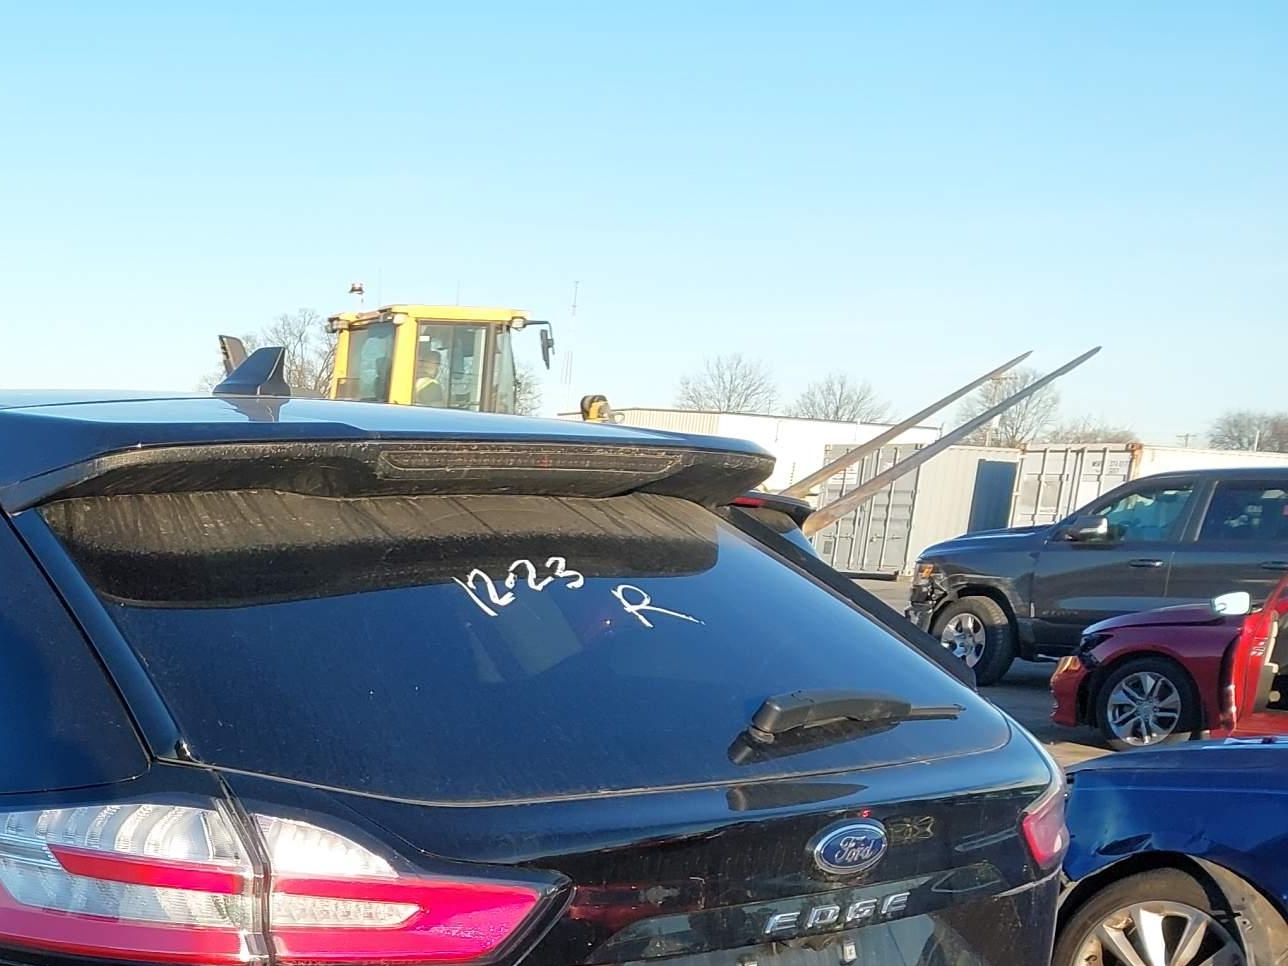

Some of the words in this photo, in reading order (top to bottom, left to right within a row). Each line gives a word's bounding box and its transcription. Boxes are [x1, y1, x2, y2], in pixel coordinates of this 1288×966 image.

[611, 584, 706, 628] R
[834, 836, 876, 863] Ford
[763, 891, 911, 935] EDGE
